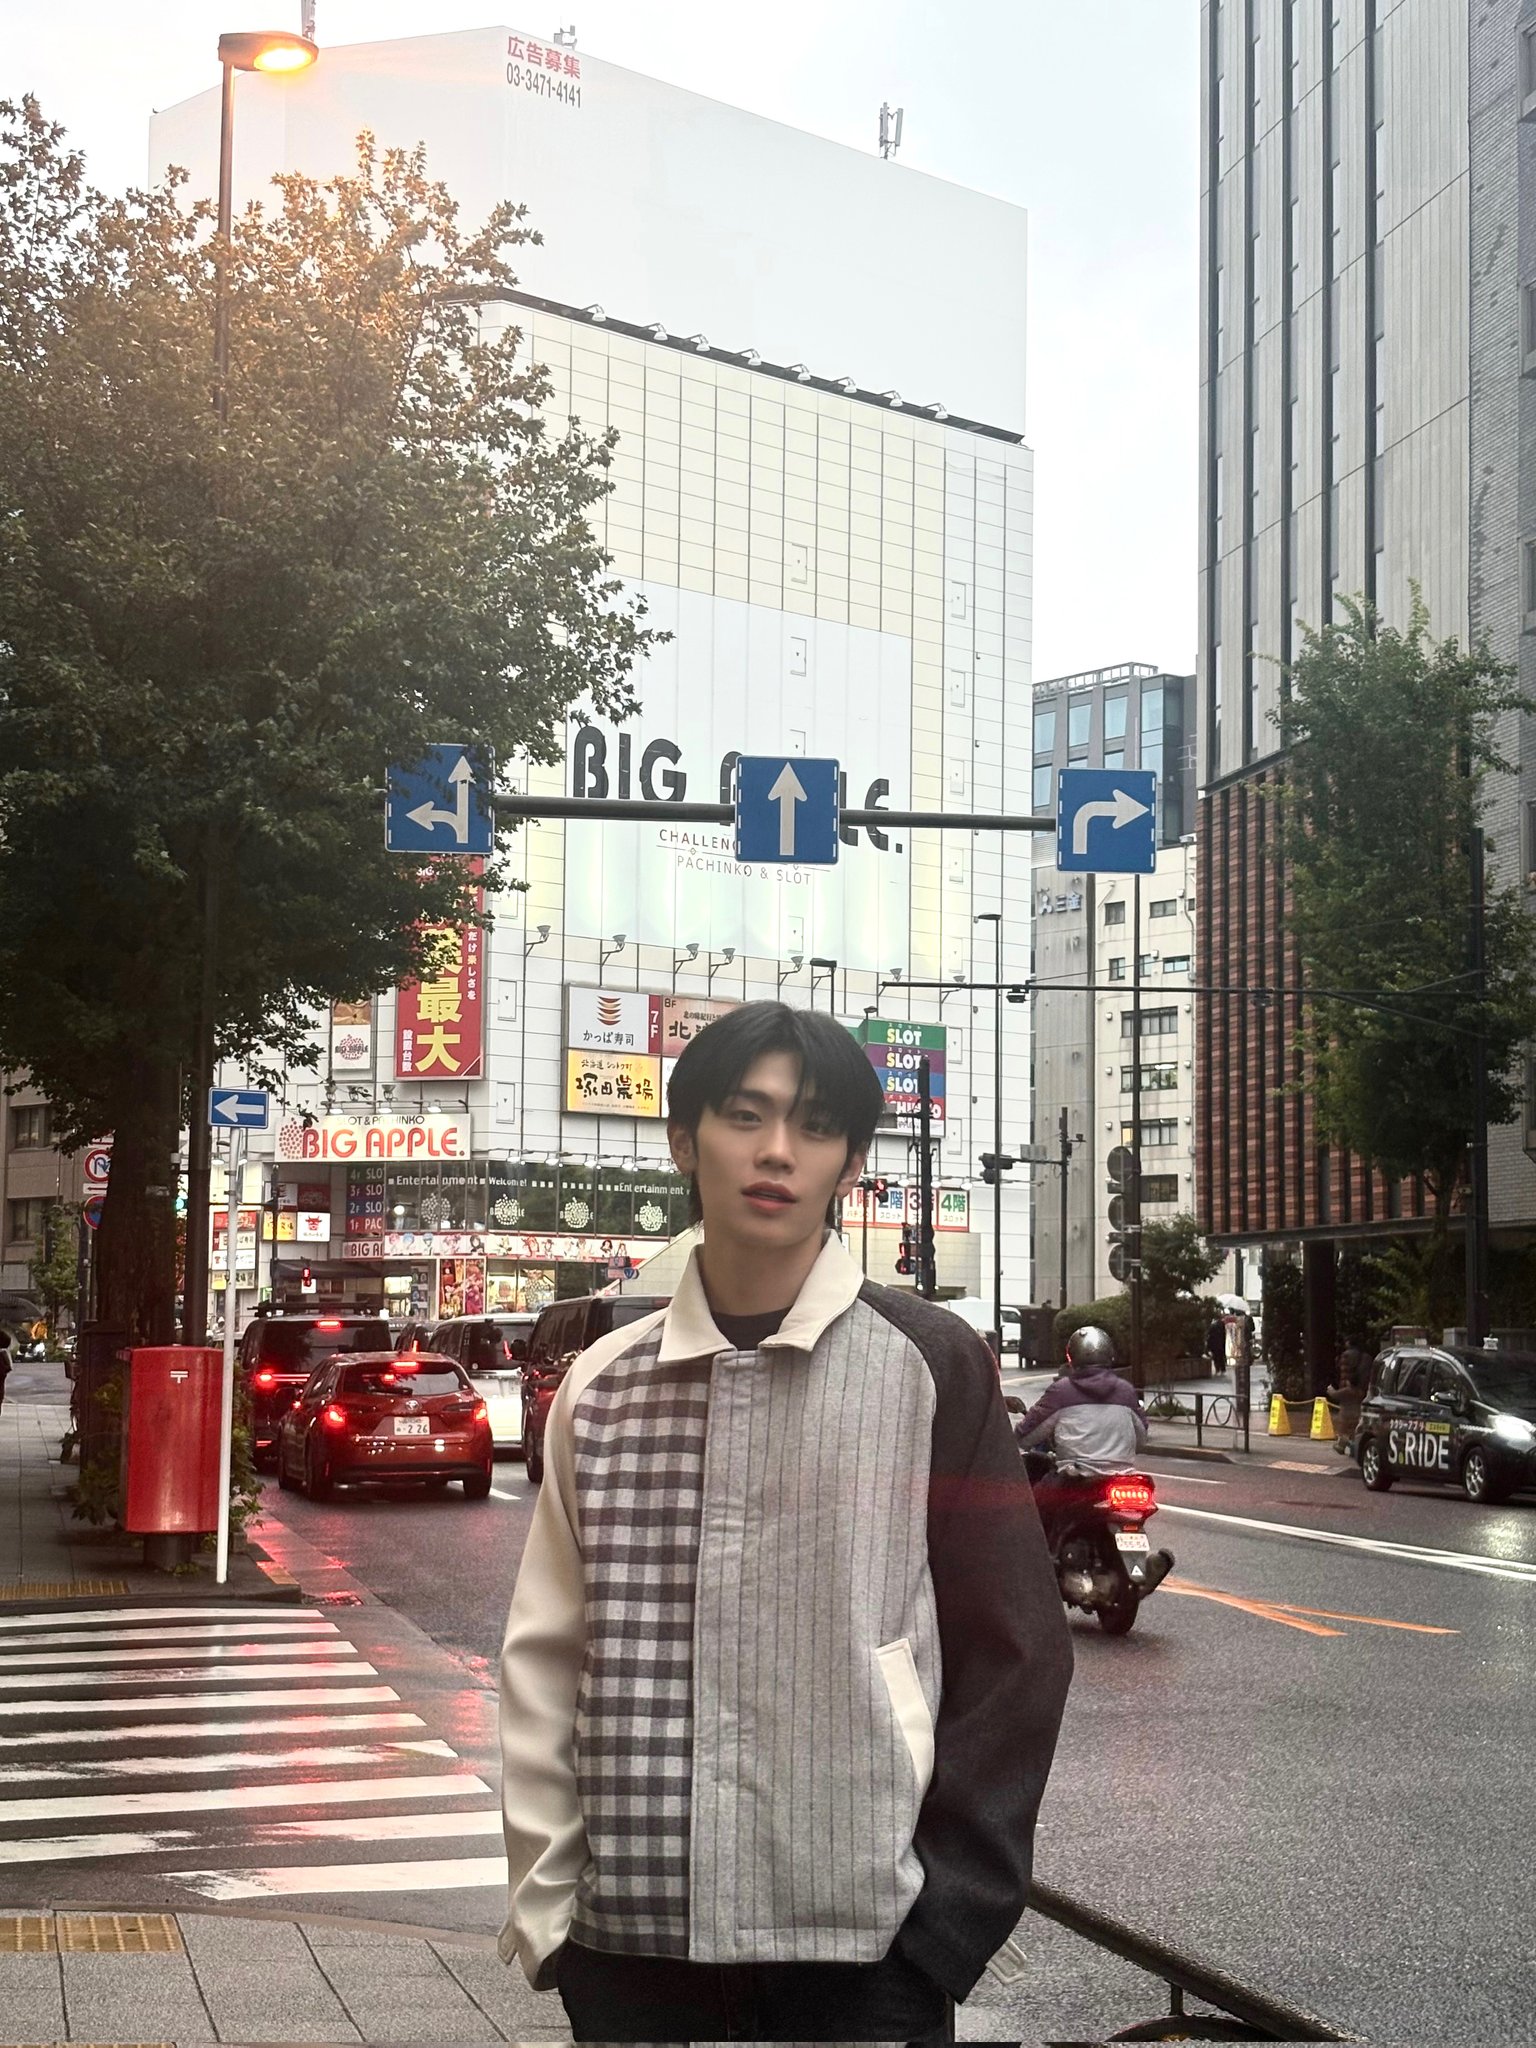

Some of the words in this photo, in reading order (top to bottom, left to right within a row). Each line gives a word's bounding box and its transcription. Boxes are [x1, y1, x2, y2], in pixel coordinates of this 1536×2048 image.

[507, 35, 581, 79] 広告募集
[506, 62, 581, 108] 03-3471-4141
[573, 725, 687, 802] BIG
[676, 855, 753, 878] PACHINKO
[760, 866, 769, 881] &
[776, 868, 812, 887] SLOT
[886, 1028, 922, 1046] SLOT
[302, 1128, 357, 1159] BIG
[940, 1193, 967, 1213] 4階
[351, 1242, 370, 1257] BIG
